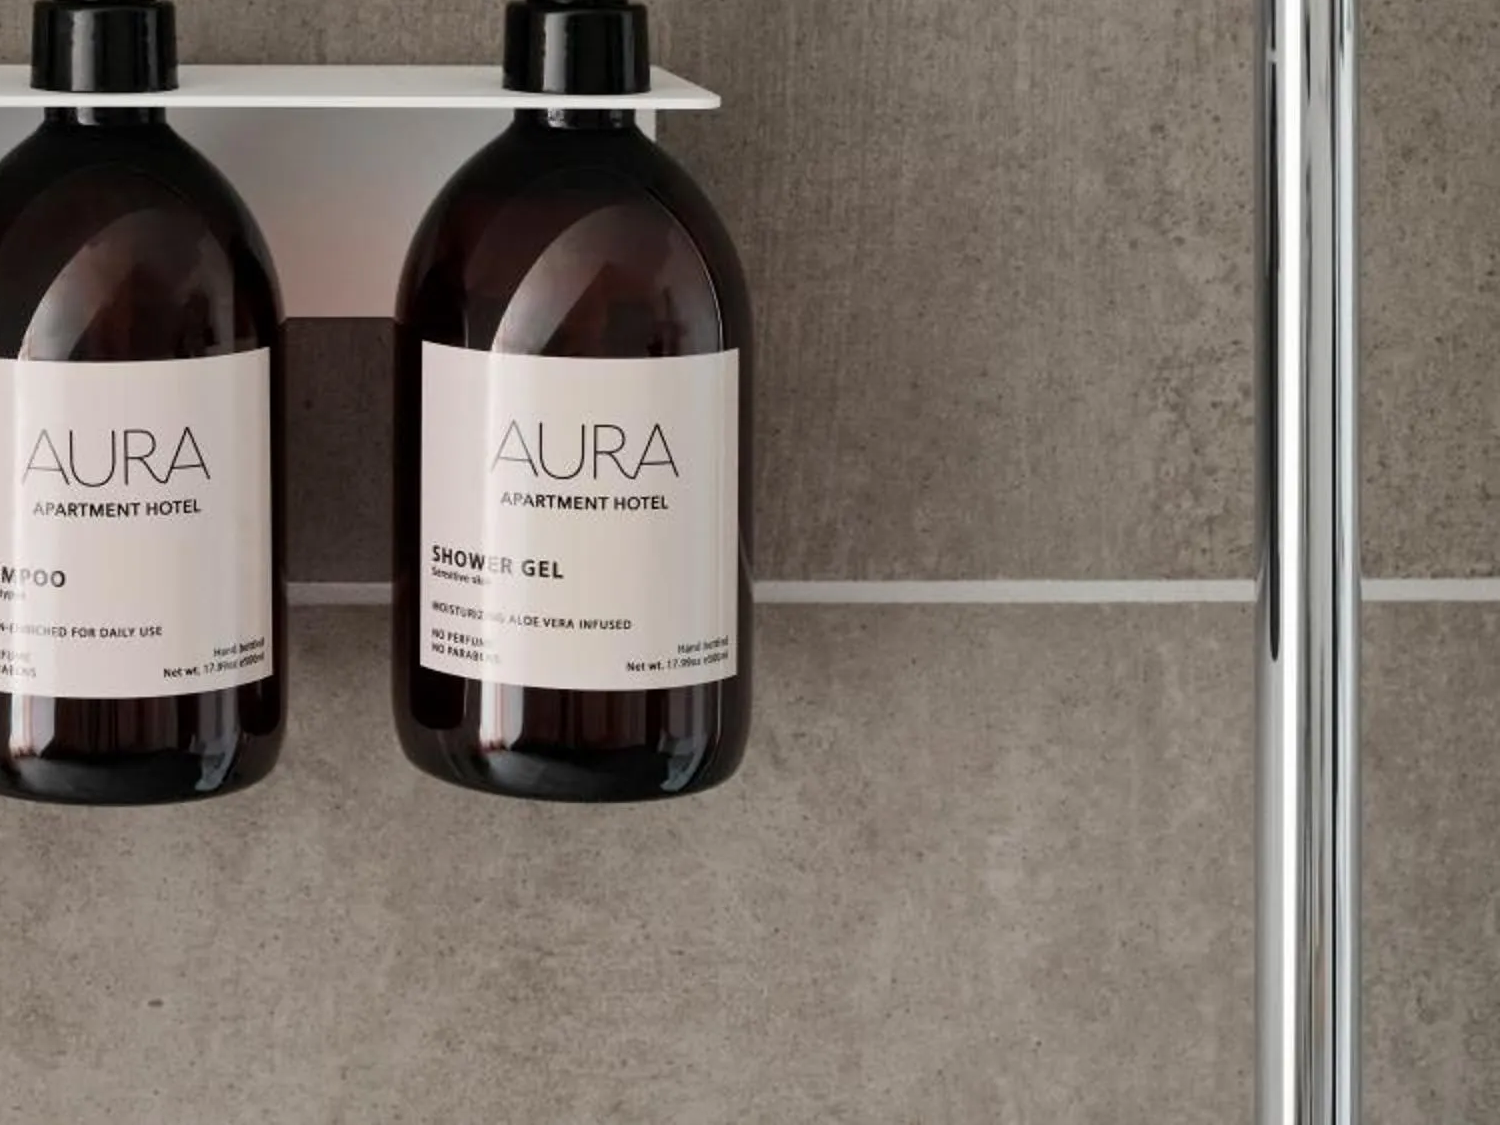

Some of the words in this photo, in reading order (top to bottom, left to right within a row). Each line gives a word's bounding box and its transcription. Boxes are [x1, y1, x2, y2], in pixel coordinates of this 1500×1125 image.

[22, 427, 211, 488] AURA
[491, 419, 679, 480] AURA
[32, 501, 140, 518] APARTMENT
[145, 499, 202, 516] HOTEL
[500, 491, 609, 510] APARTMENT
[614, 494, 669, 511] HOTEL
[432, 545, 512, 574] SHOWER
[521, 559, 564, 580] GEL
[431, 601, 505, 623] MOISTURIZG
[509, 615, 539, 627] ALOE
[543, 618, 574, 630] VERA
[579, 619, 632, 631] INFUSED
[71, 626, 96, 637] FOR
[99, 626, 136, 638] DAILY
[139, 626, 163, 636] USE
[431, 628, 444, 640] NO
[447, 631, 494, 649] PERFUM
[431, 642, 444, 654] NO
[163, 668, 182, 678] Net
[627, 662, 645, 672] Net
[648, 660, 664, 671] wt.
